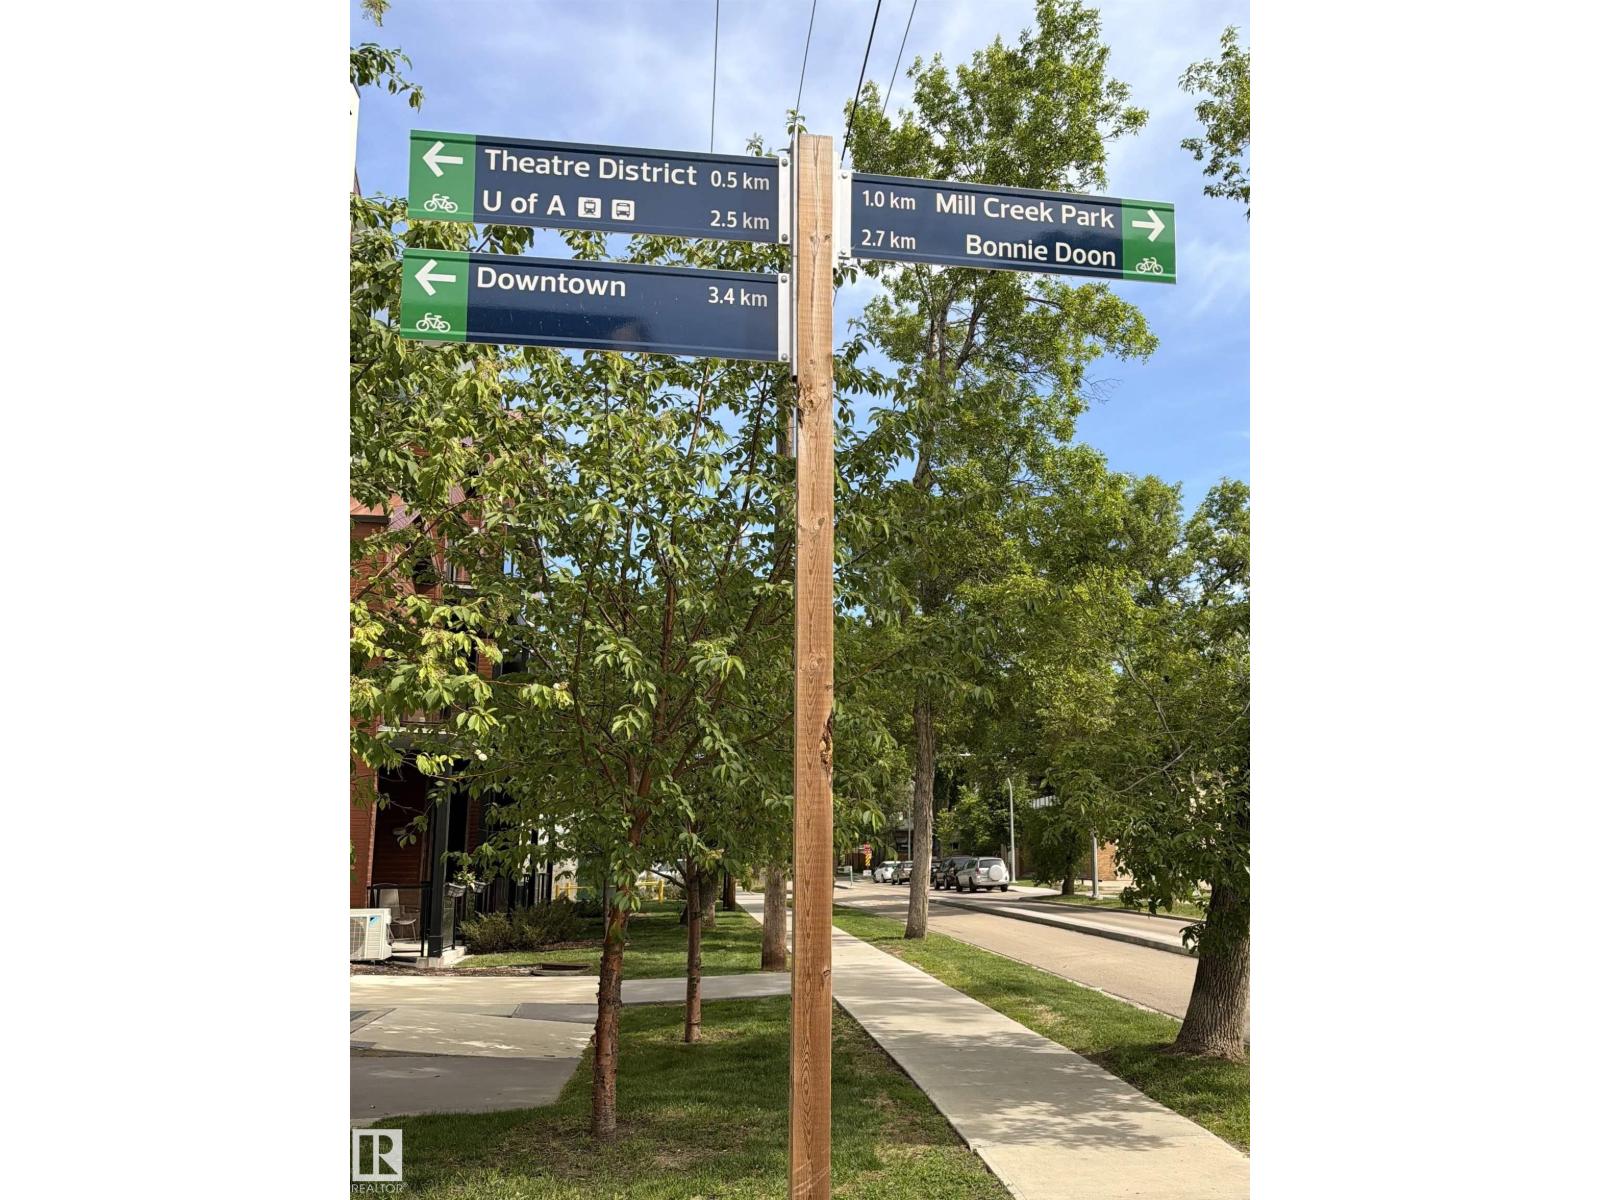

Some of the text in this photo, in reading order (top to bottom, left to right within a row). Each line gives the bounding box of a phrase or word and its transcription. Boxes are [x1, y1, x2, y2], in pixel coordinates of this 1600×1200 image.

[485, 149, 770, 191] Theatre District 0.5 km
[482, 190, 770, 231] U of A 2.5 km
[862, 190, 1115, 229] 1.0 km Mill Creek Park
[861, 229, 1116, 267] 2.7 km Bonnie Doon
[477, 266, 768, 308] Downtown 3.4 km
